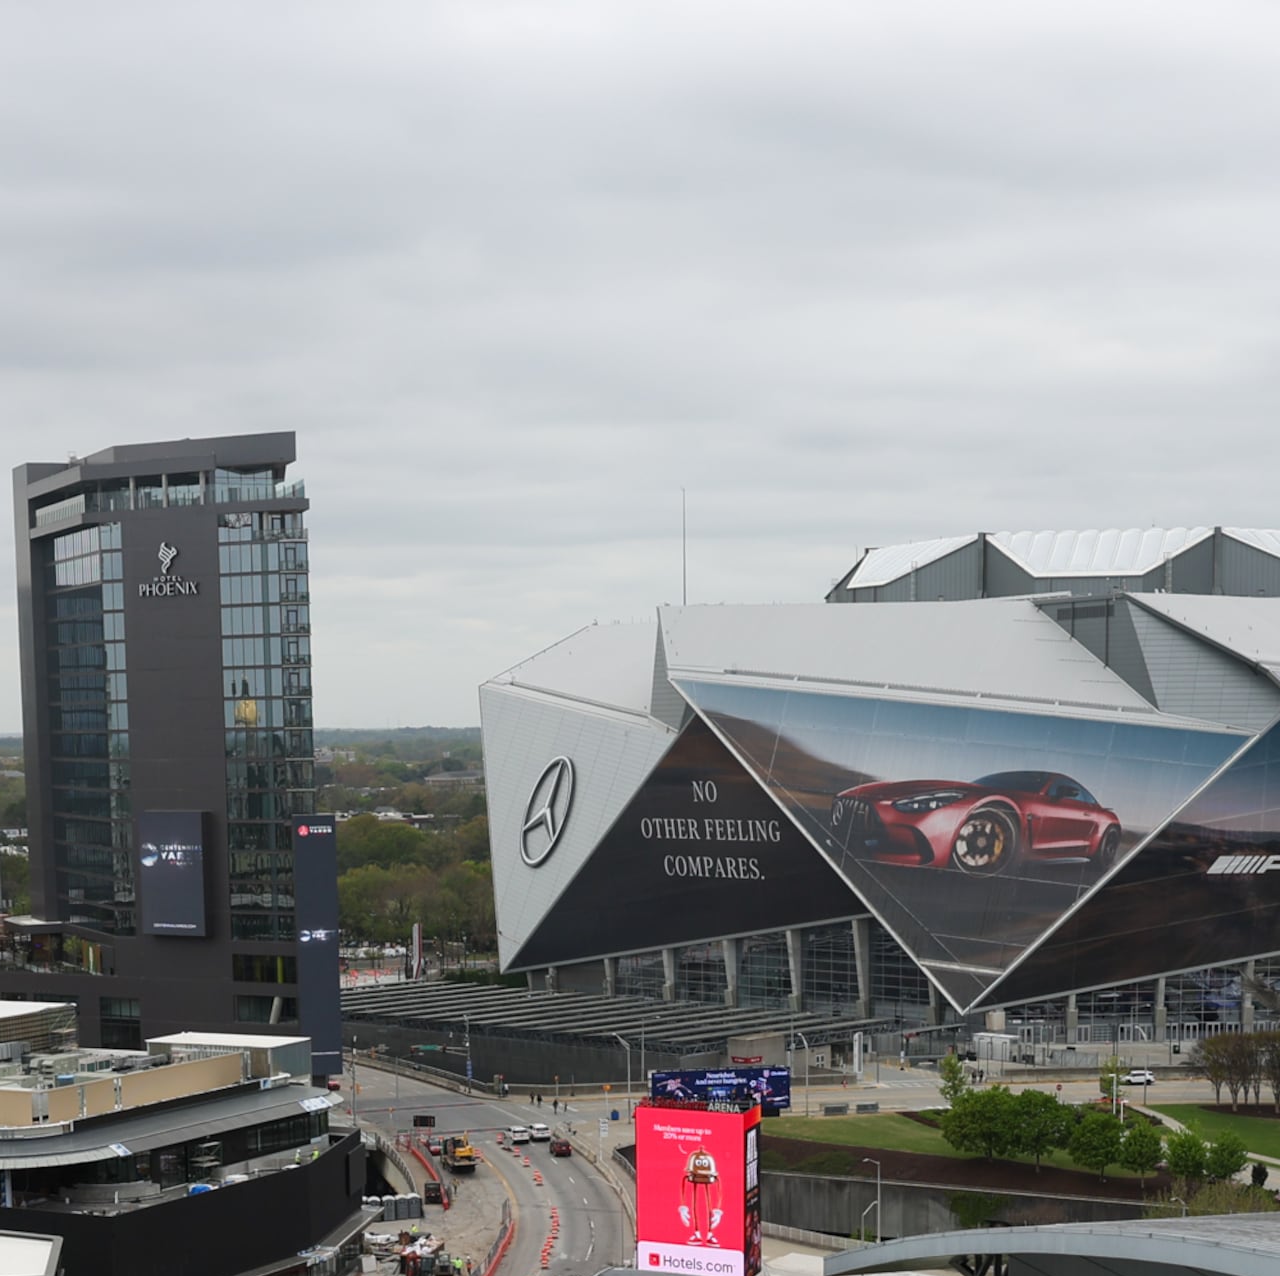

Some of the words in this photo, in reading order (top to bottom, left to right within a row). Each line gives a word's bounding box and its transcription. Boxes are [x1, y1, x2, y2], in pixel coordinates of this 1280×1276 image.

[138, 581, 199, 597] PHOENIX
[691, 780, 718, 803] NO
[640, 817, 701, 840] OTHER
[705, 819, 781, 842] FEELING
[664, 855, 766, 880] COMPARES.
[707, 1102, 740, 1113] ARENA
[663, 1256, 734, 1274] Hotels.com
